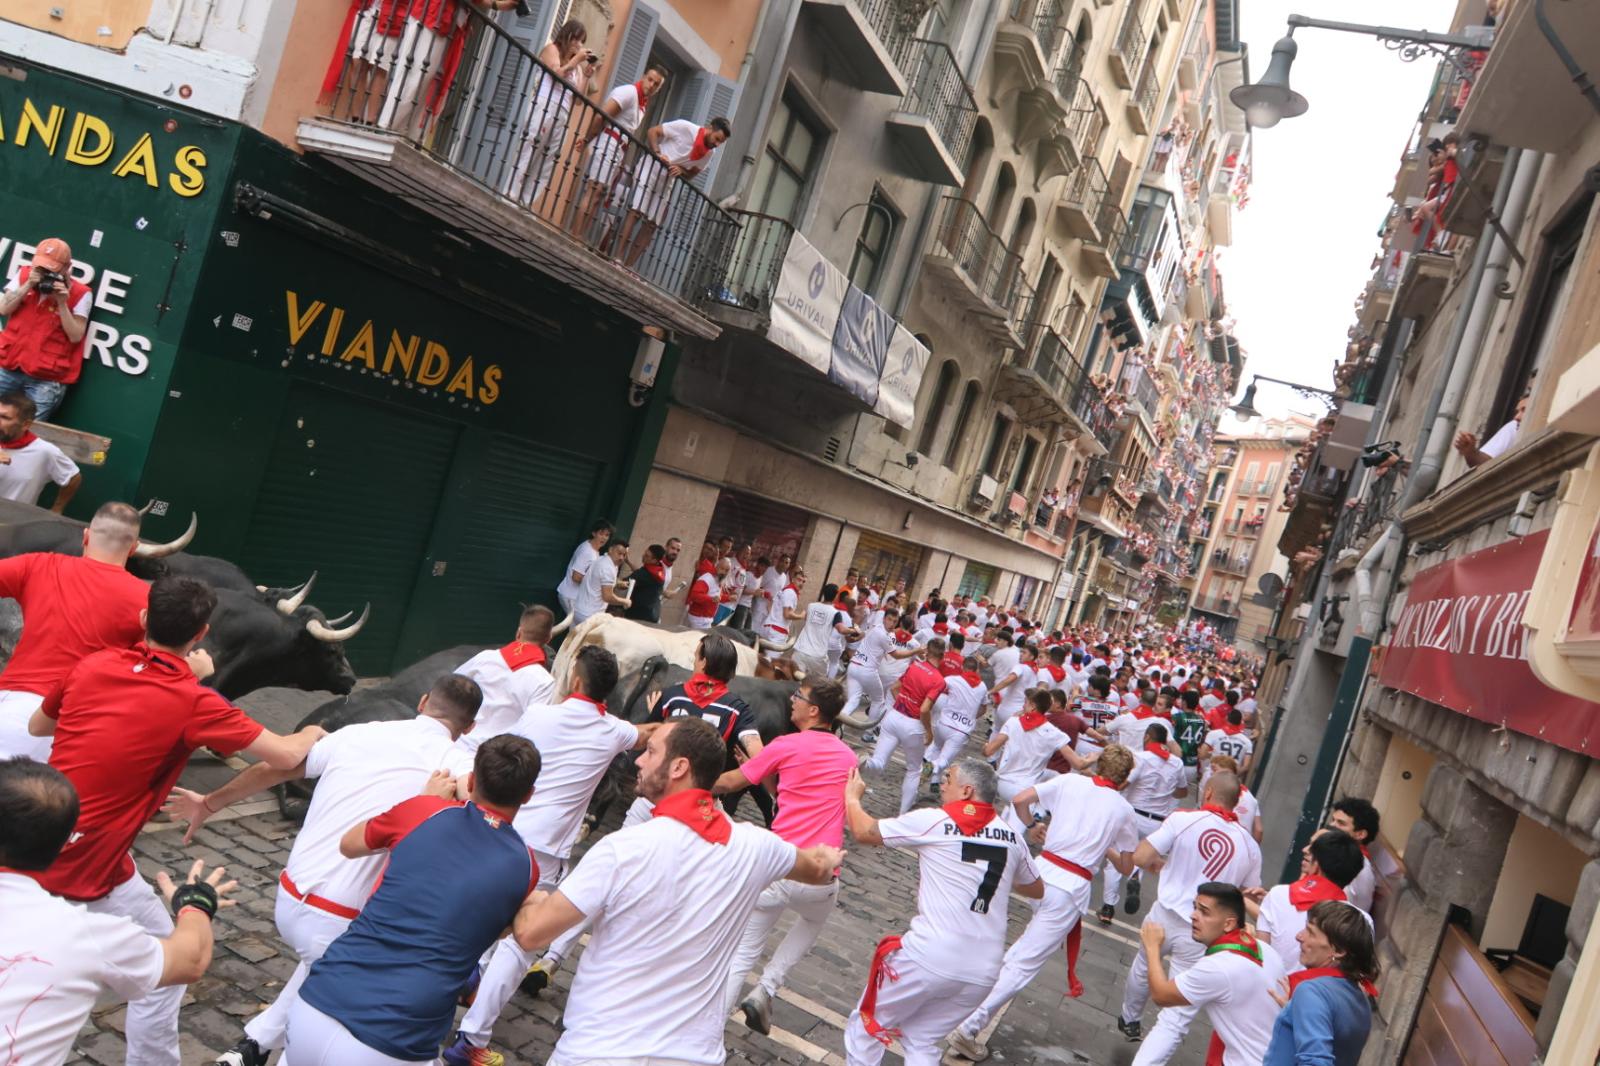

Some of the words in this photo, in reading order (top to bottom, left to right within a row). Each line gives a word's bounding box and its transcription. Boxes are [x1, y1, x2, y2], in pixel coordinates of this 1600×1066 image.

[0, 97, 208, 198] NDAS
[787, 292, 825, 329] URIVAL
[286, 289, 503, 405] VIANDAS
[1468, 593, 1502, 655] Y
[1180, 725, 1203, 745] 46
[1219, 741, 1244, 760] 97
[944, 823, 1018, 845] PAPLONA
[1198, 828, 1235, 881] 9
[961, 841, 1008, 914] 7
